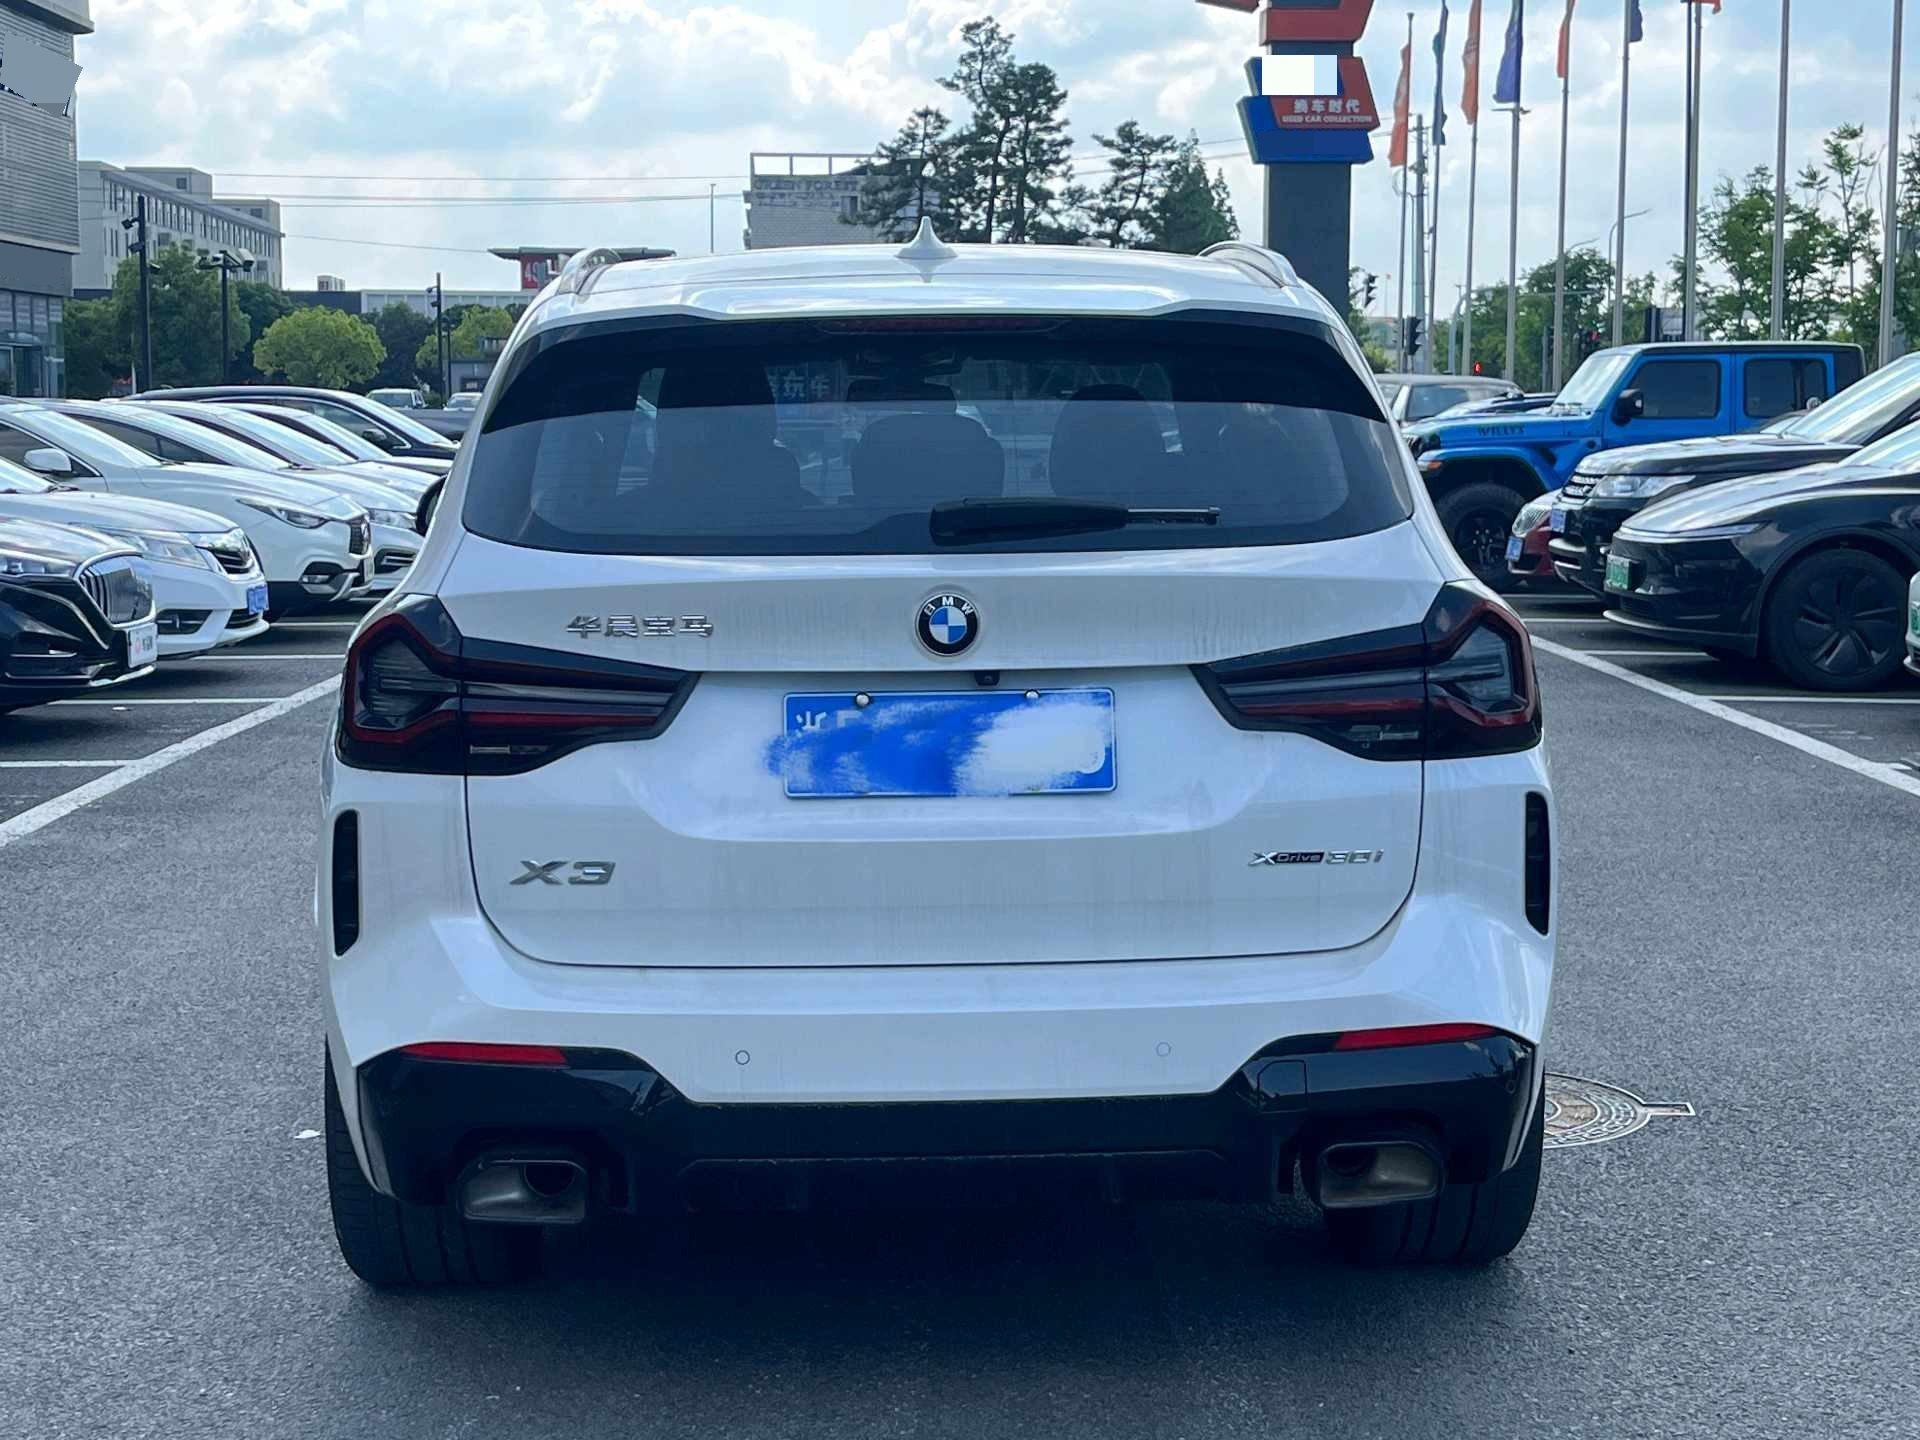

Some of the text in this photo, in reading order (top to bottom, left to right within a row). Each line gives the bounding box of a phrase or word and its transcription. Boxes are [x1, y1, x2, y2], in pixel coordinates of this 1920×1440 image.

[1305, 115, 1321, 123] CAR
[923, 596, 974, 616] BMW
[565, 614, 714, 639] 华晨宝马
[508, 859, 617, 886] X3
